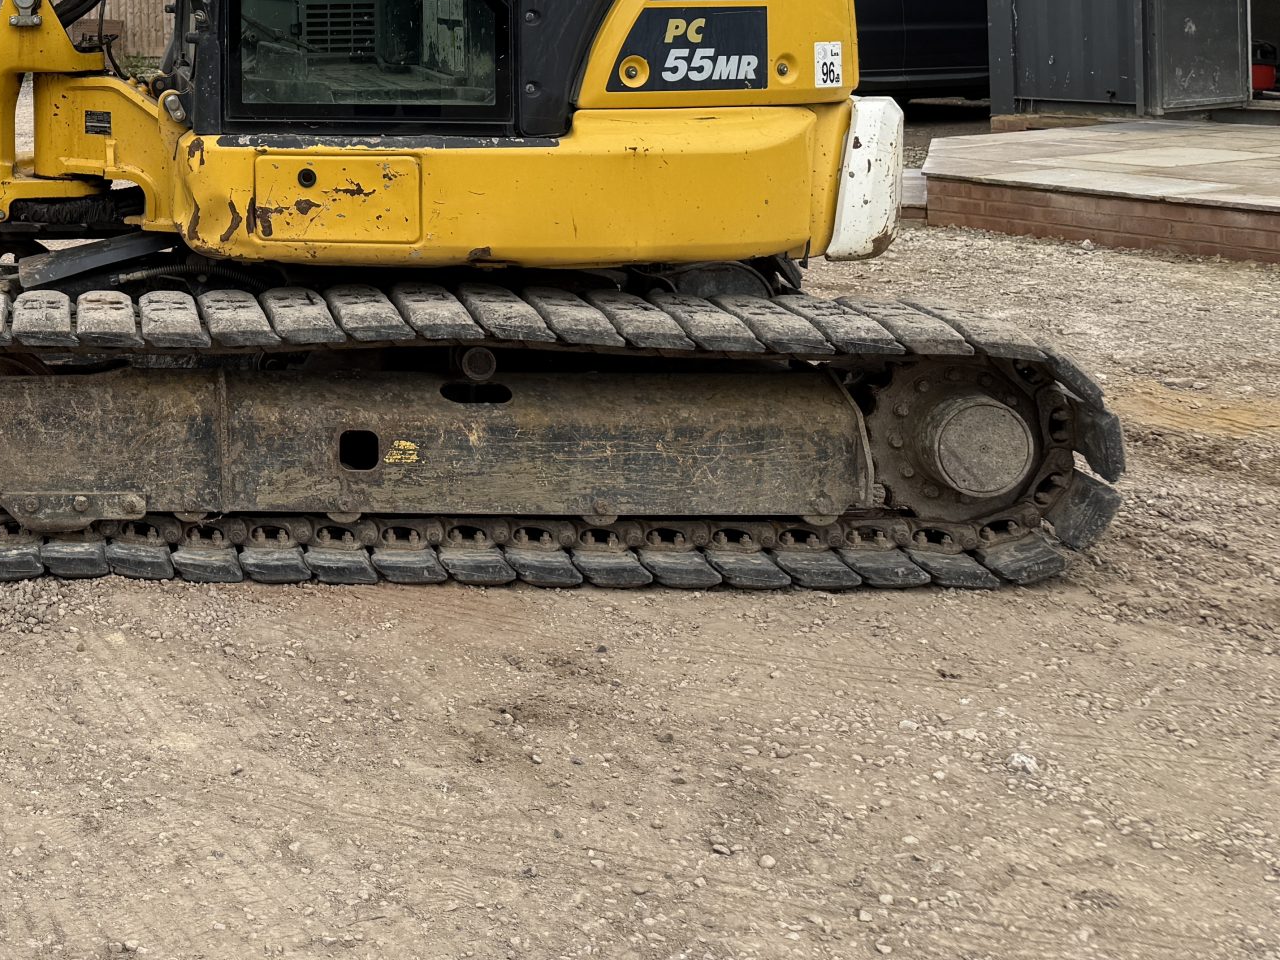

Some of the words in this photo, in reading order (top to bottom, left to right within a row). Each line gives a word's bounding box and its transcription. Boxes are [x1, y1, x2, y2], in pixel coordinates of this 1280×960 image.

[664, 18, 706, 43] PC
[661, 47, 759, 82] 55MR
[821, 61, 835, 83] 96
